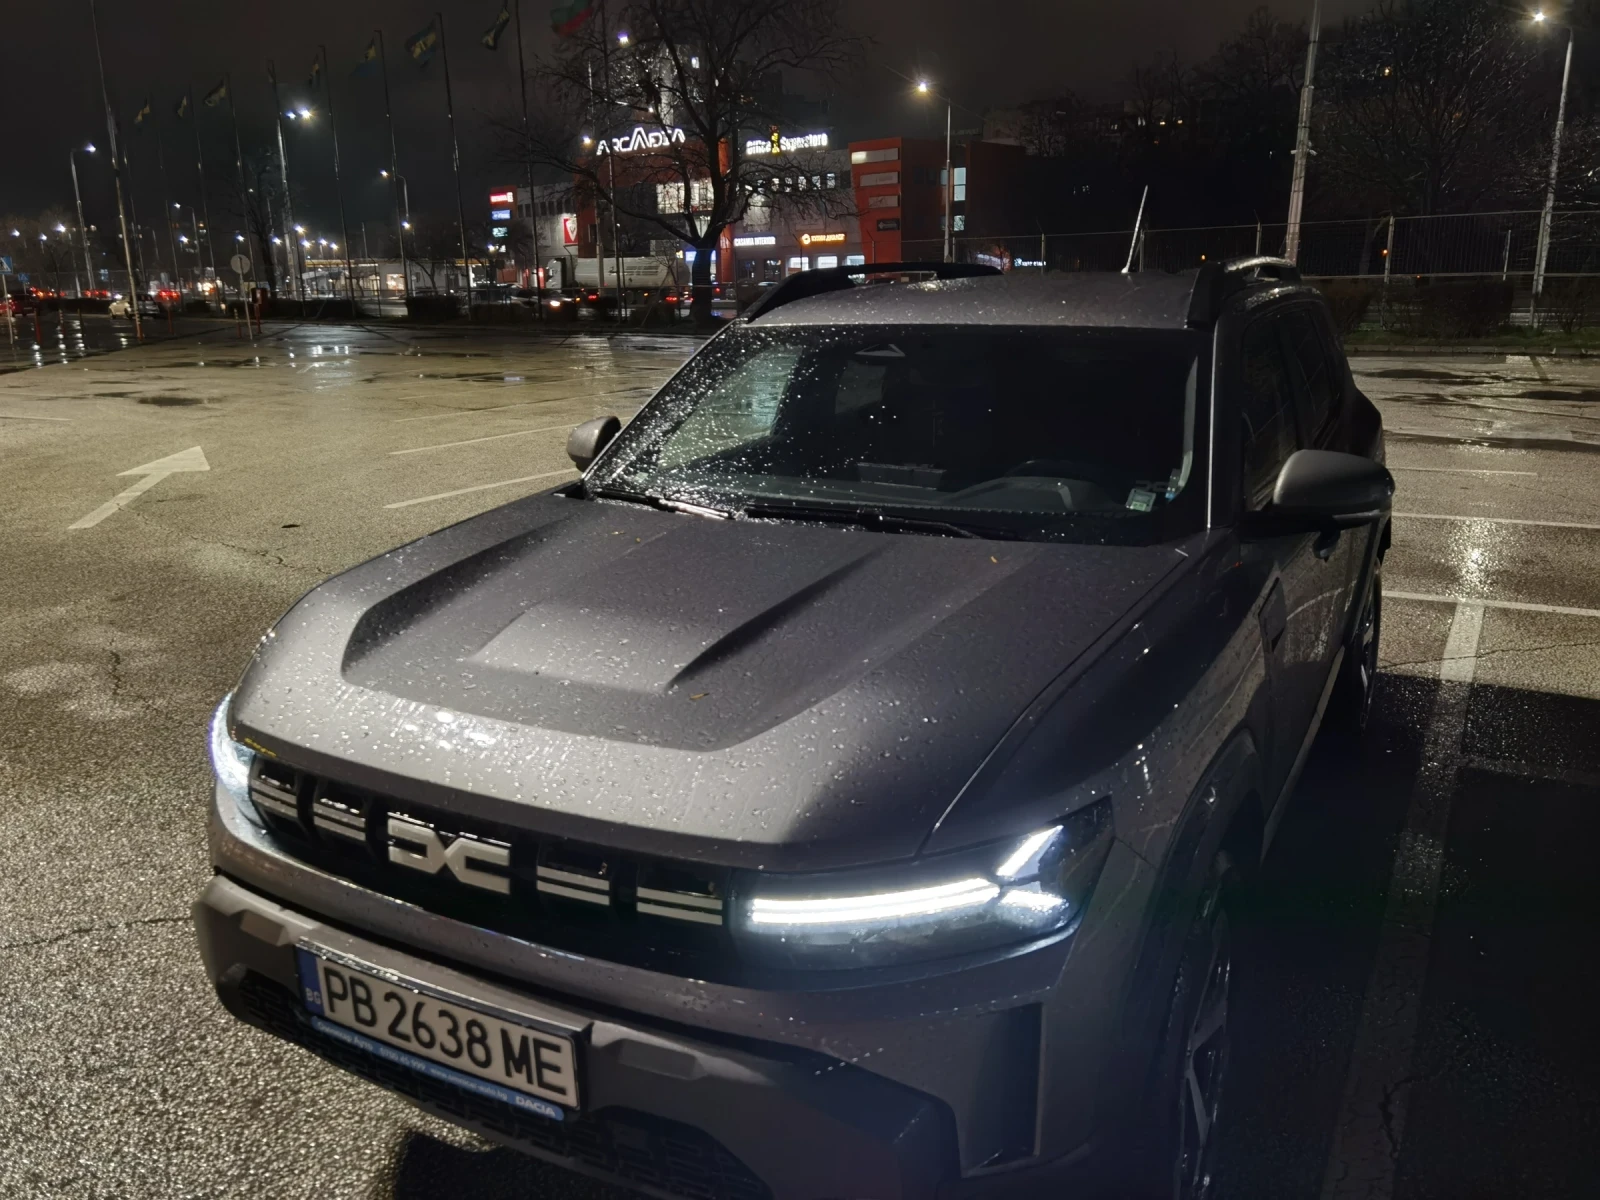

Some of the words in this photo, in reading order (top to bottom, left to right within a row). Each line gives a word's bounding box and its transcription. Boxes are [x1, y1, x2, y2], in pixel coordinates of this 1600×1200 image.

[596, 126, 686, 155] ARCADIA
[305, 988, 321, 1005] BG
[324, 966, 377, 1027] PB
[384, 991, 492, 1068] 2638
[501, 1028, 567, 1096] ME
[515, 1095, 556, 1117] DACIA
